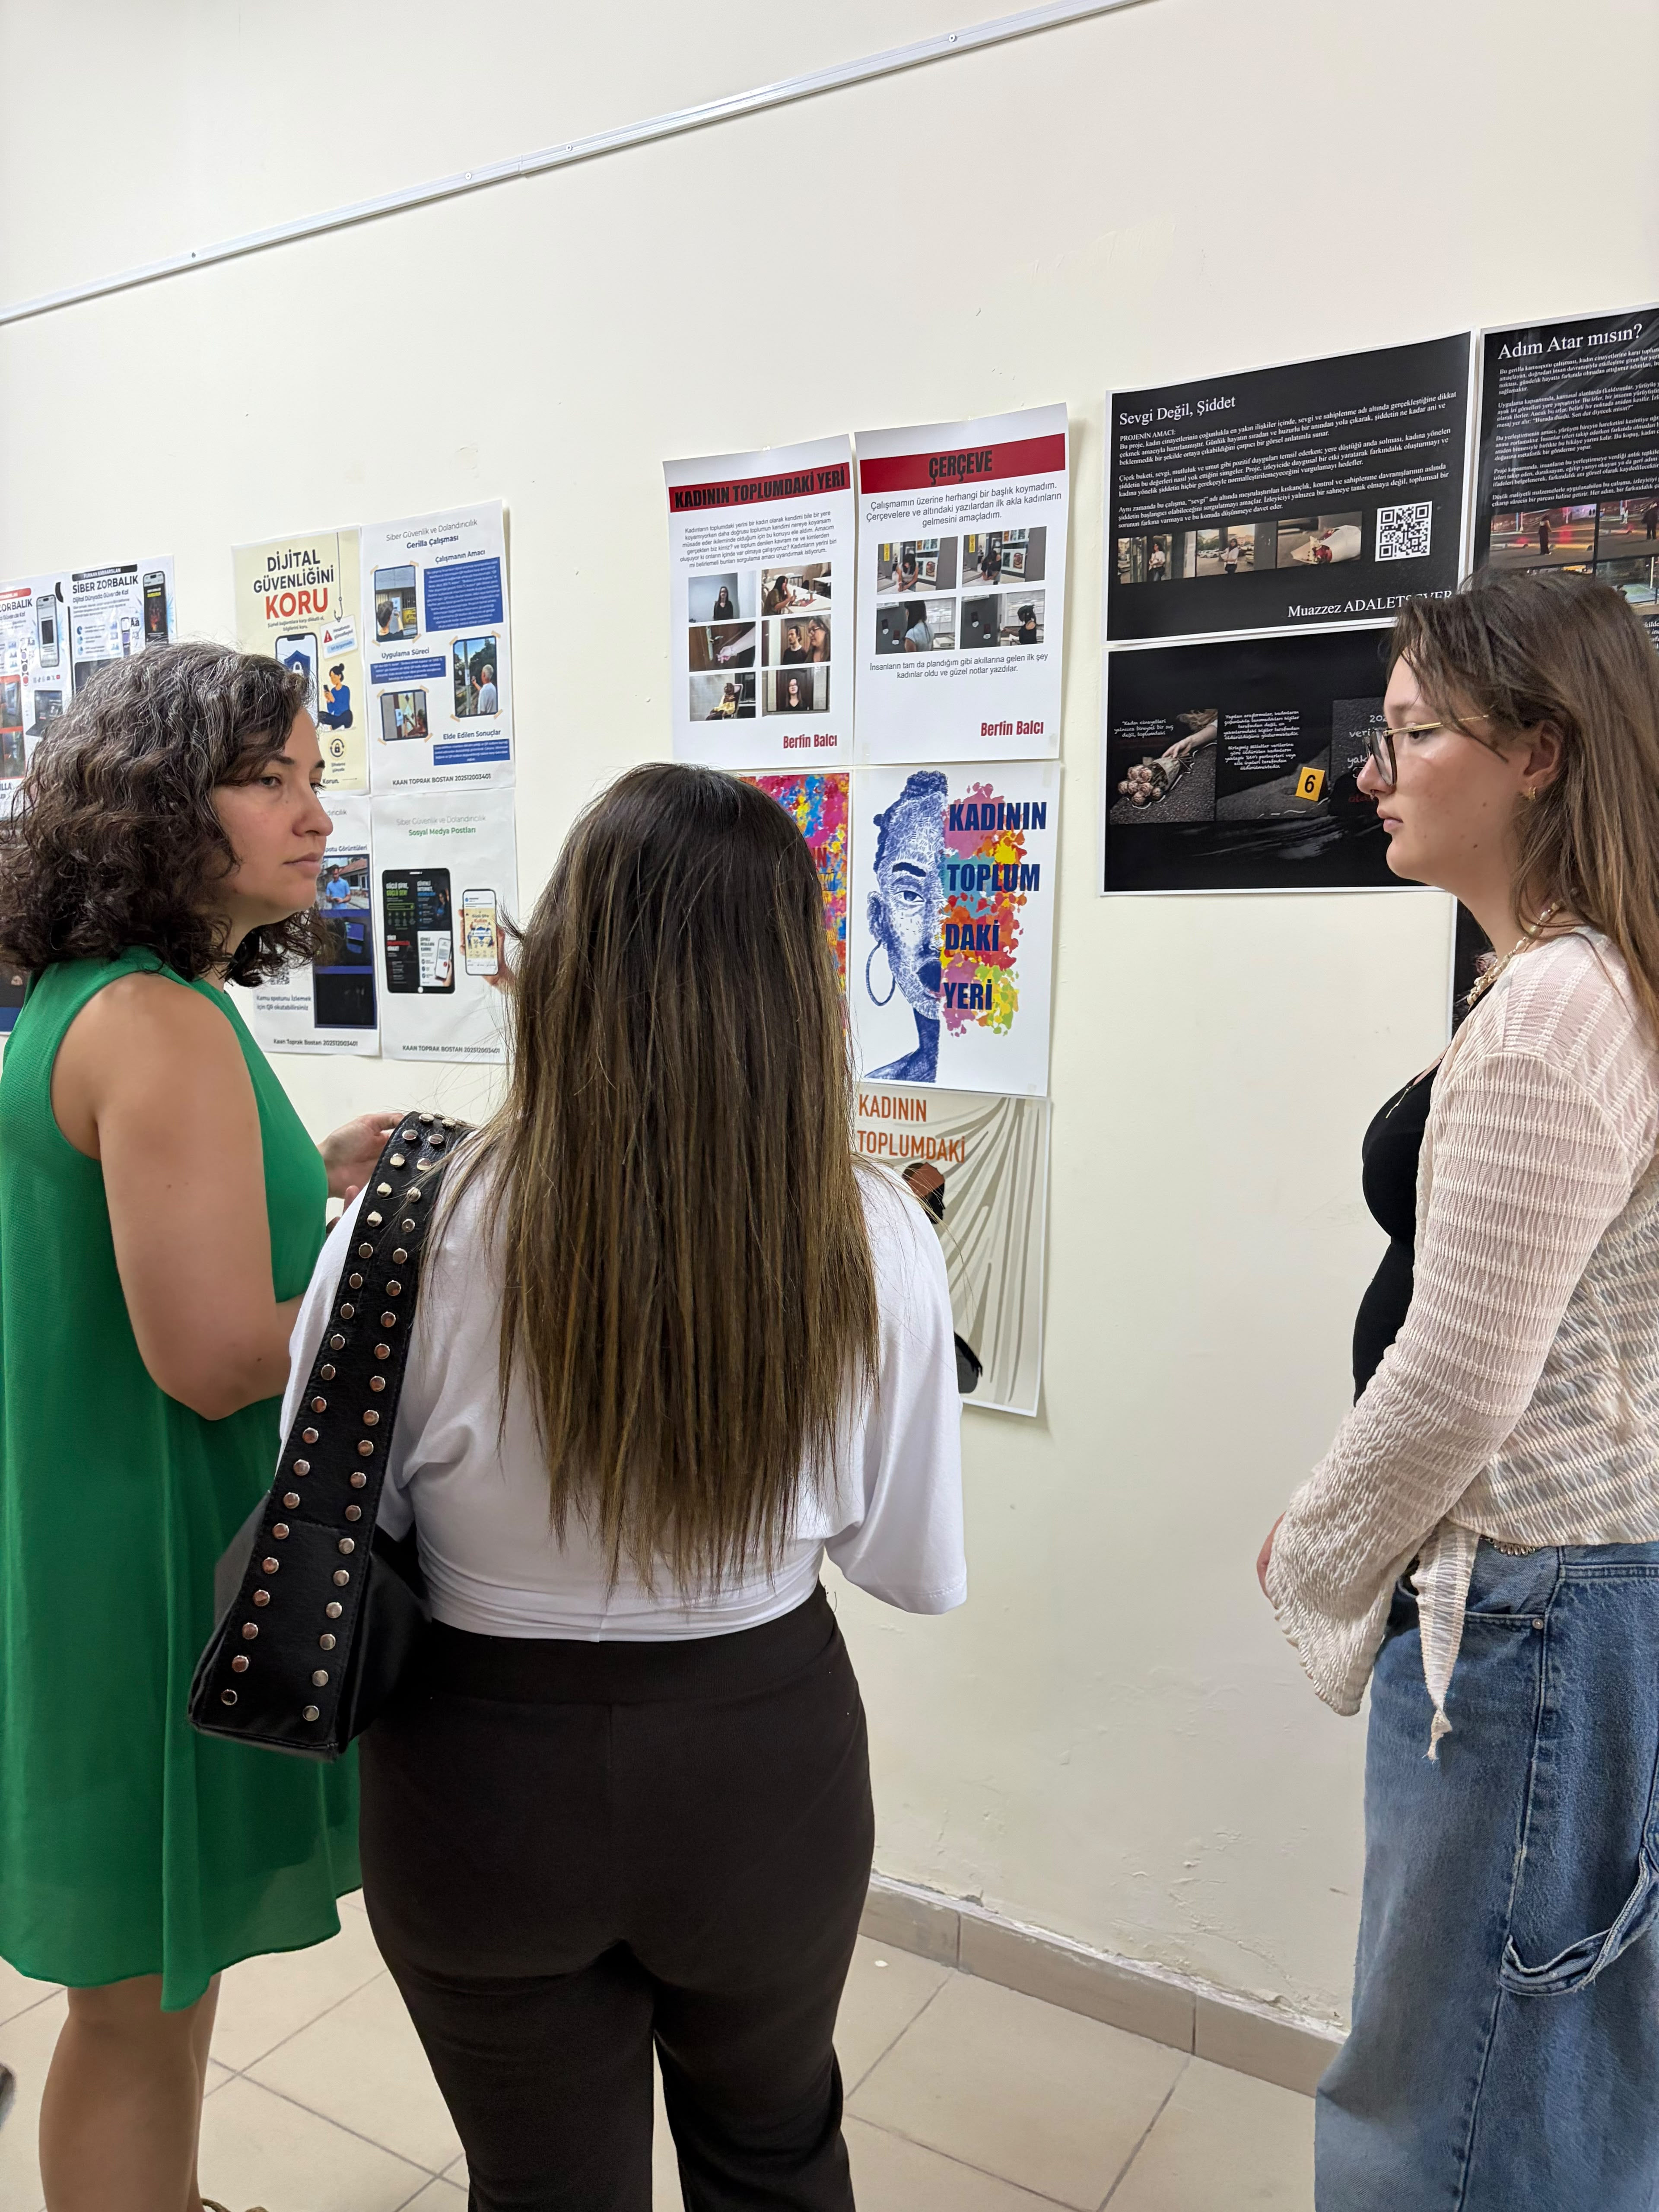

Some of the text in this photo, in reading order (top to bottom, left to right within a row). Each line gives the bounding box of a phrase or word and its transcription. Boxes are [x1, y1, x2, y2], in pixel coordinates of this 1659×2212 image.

[1498, 323, 1643, 359] Adım Atar mısın?
[1119, 396, 1236, 425] Sevgi Değil, Şiddet
[1162, 434, 1198, 444] cinayetlerinin
[1199, 429, 1229, 439] çoğunlukla
[1239, 426, 1253, 434] yakın
[1255, 422, 1276, 430] ilişkiler
[1324, 410, 1357, 419] sahiplenme
[1369, 404, 1389, 412] altında
[1437, 392, 1456, 400] dikkat
[1119, 457, 1153, 465] beklenmedik
[1266, 437, 1283, 446] görsel
[1284, 433, 1311, 442] anlatımla
[1120, 432, 1151, 441] PROJENİN
[929, 450, 992, 486] ÇERÇEVE
[675, 466, 845, 509] KADININ TOPLUMDAKİ YERİ
[871, 500, 914, 510] Çalışmamın
[917, 496, 943, 505] üzerine
[946, 491, 977, 501] herhangi
[992, 487, 1013, 498] başlık
[1016, 483, 1056, 495] koymadım.
[866, 509, 910, 522] Çerçevelere
[923, 505, 953, 515] altındaki
[956, 501, 994, 513] yazılardan
[1006, 497, 1021, 505] akla
[1024, 493, 1061, 503] kadınların
[922, 512, 1001, 528] gelmesini amaçladım.
[403, 528, 429, 538] Güvenlik
[407, 536, 458, 549] Gerilla Çalışması
[267, 549, 321, 572] DİJİTAL
[435, 553, 466, 563] Çalışmanın
[72, 575, 138, 594] SİBER ZORBALIK
[254, 565, 334, 593] GÜVENLİĞİNİ
[266, 588, 328, 620] KORU
[1288, 605, 1341, 617] Muazzez
[381, 651, 410, 659] Uygulama
[927, 659, 958, 668] plandığım
[960, 658, 972, 667] gibi
[1006, 655, 1025, 664] gelen
[950, 668, 967, 677] güzel
[990, 665, 1017, 674] yazdılar.
[783, 734, 837, 749] Berfin Balcı
[981, 721, 1044, 736] Berfin Balcı
[1305, 775, 1316, 793] 6
[949, 801, 1047, 832] KADININ
[947, 864, 1039, 892] TOPLUM
[945, 919, 1000, 951] DAKİ
[944, 979, 993, 1010] YERİ
[858, 1093, 927, 1122] KADININ
[857, 1130, 966, 1163] TOPLUMDAKİ
